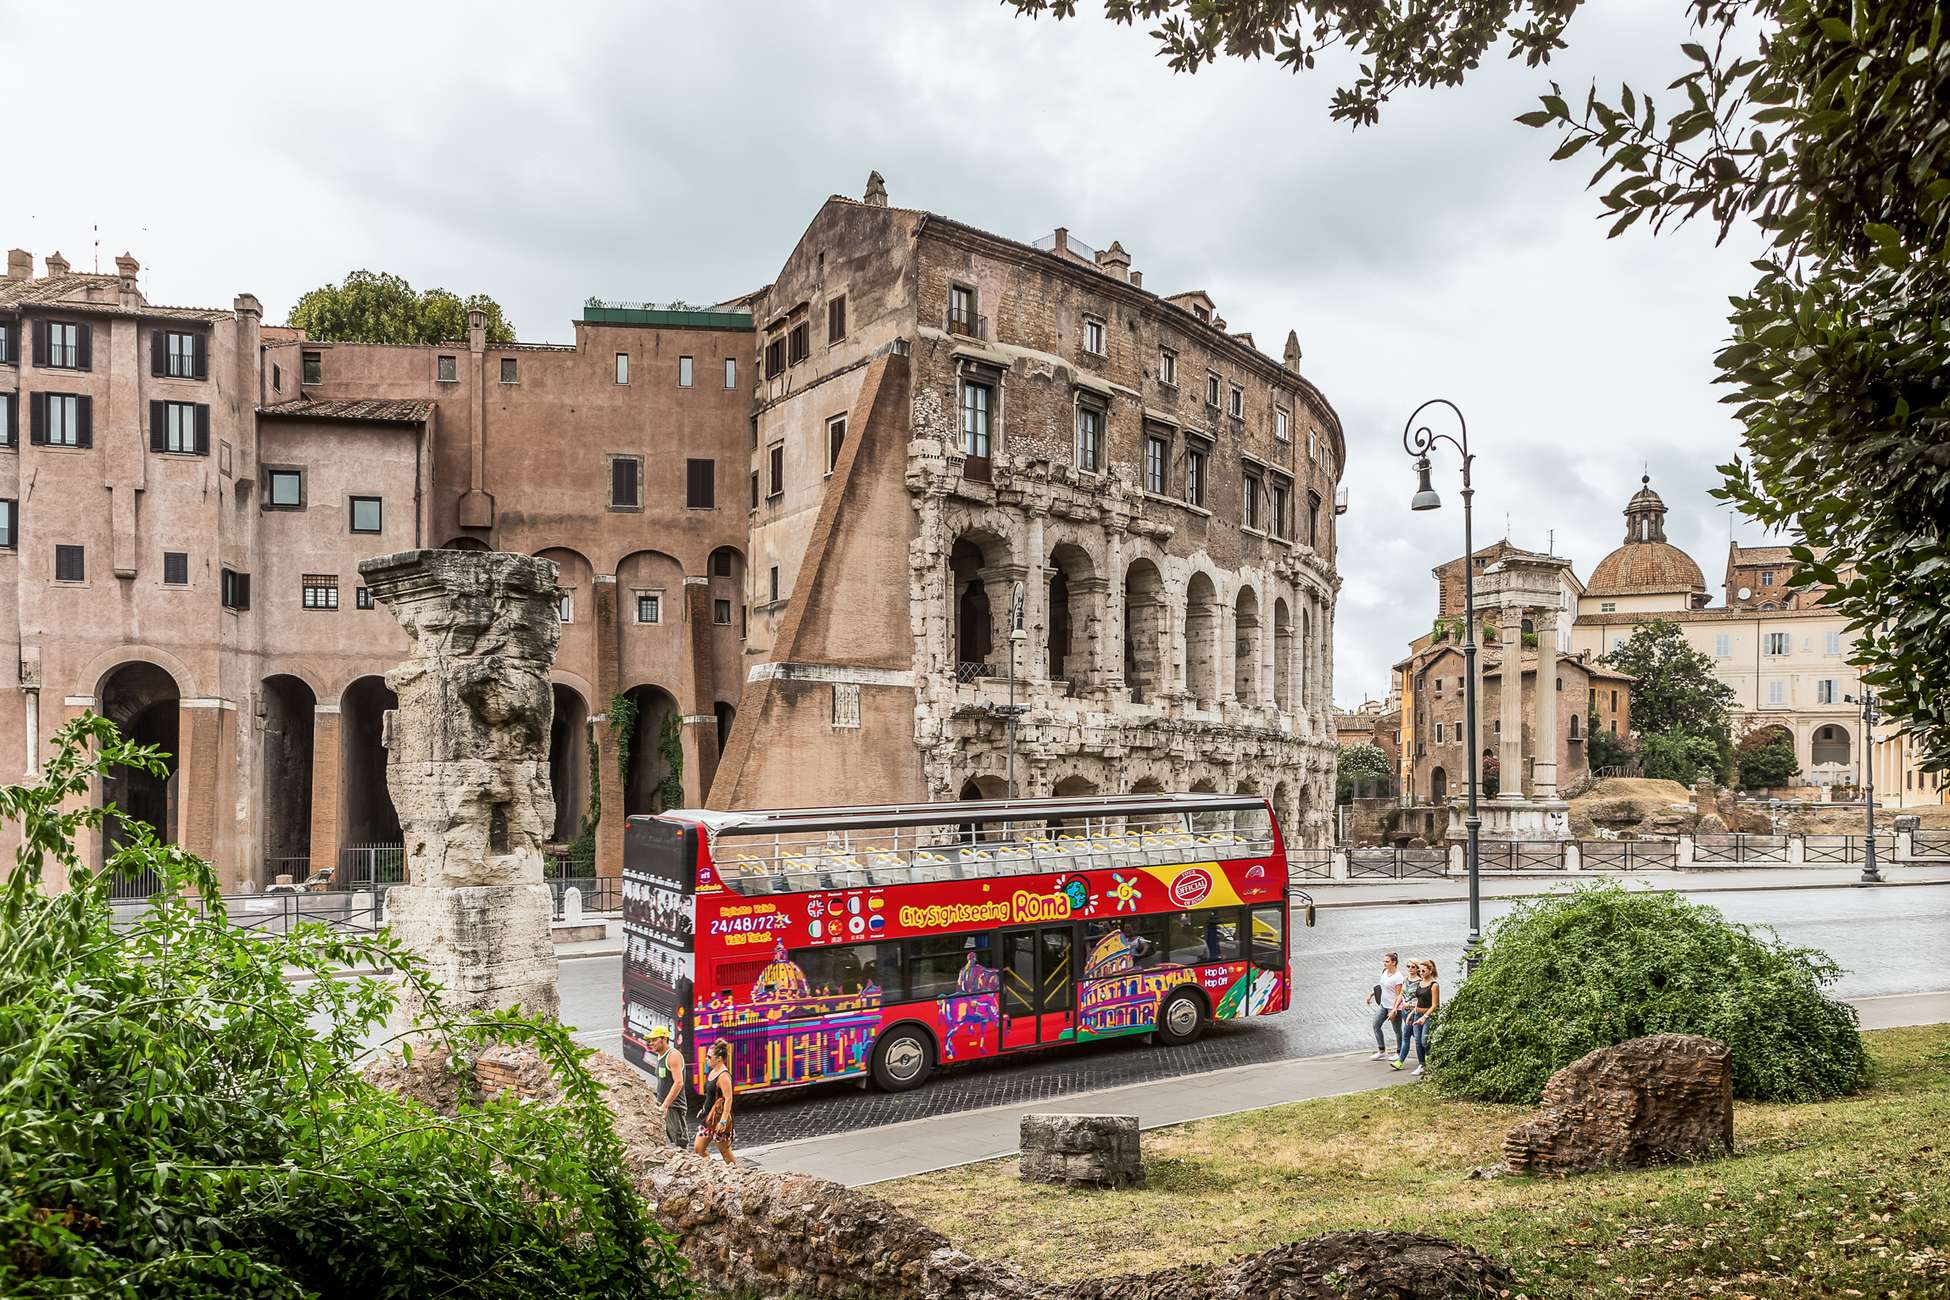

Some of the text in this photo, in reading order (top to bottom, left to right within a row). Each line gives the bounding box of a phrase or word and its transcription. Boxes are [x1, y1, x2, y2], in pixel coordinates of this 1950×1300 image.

[1177, 880, 1206, 896] OFFICIAL
[900, 889, 1071, 928] CitySightseeing Roma
[710, 915, 775, 935] 24/48/72
[1204, 966, 1228, 977] Hop On
[1204, 977, 1229, 988] Hop Off
